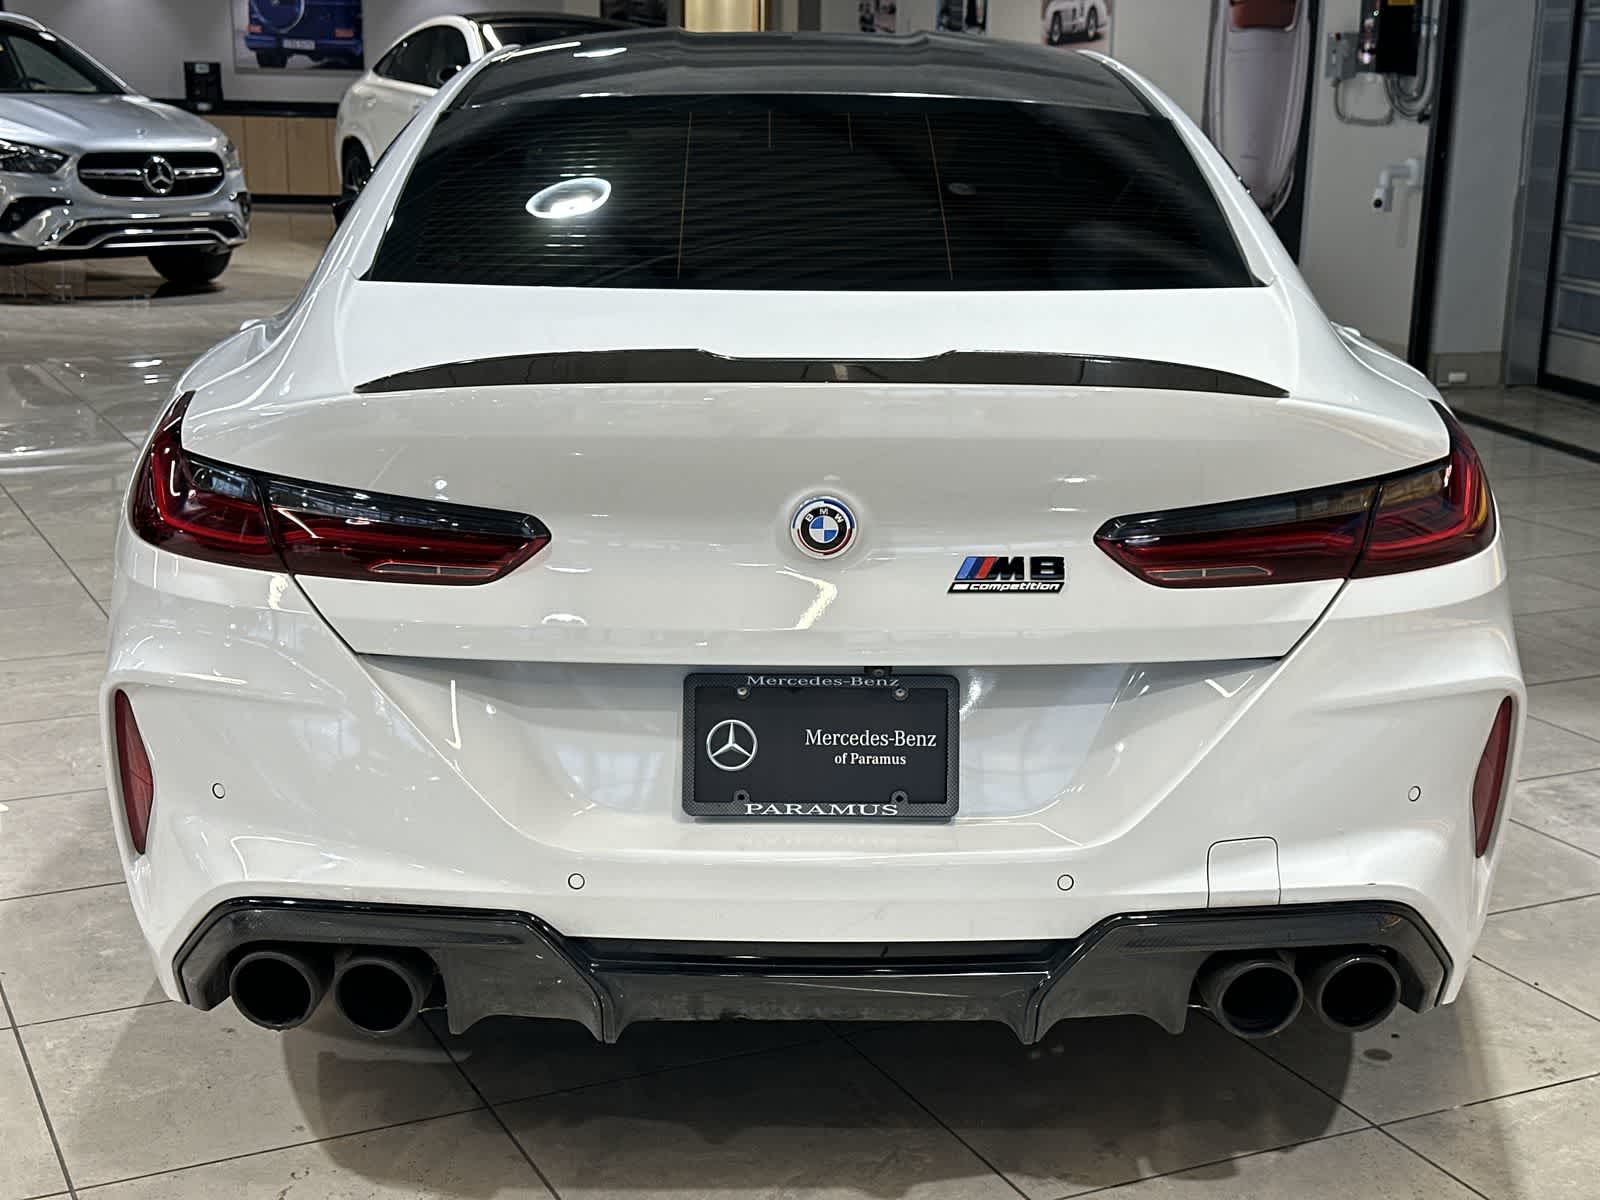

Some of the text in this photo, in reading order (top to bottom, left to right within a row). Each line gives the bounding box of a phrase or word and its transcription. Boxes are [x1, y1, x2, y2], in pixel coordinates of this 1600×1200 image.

[805, 508, 844, 523] BMW
[982, 556, 1064, 580] M8
[969, 582, 1060, 592] competition
[746, 675, 899, 687] Mercedes-Benz
[805, 729, 937, 747] Mercedes-Benz
[834, 752, 907, 766] of Paramus
[744, 803, 899, 816] PARAMUS
